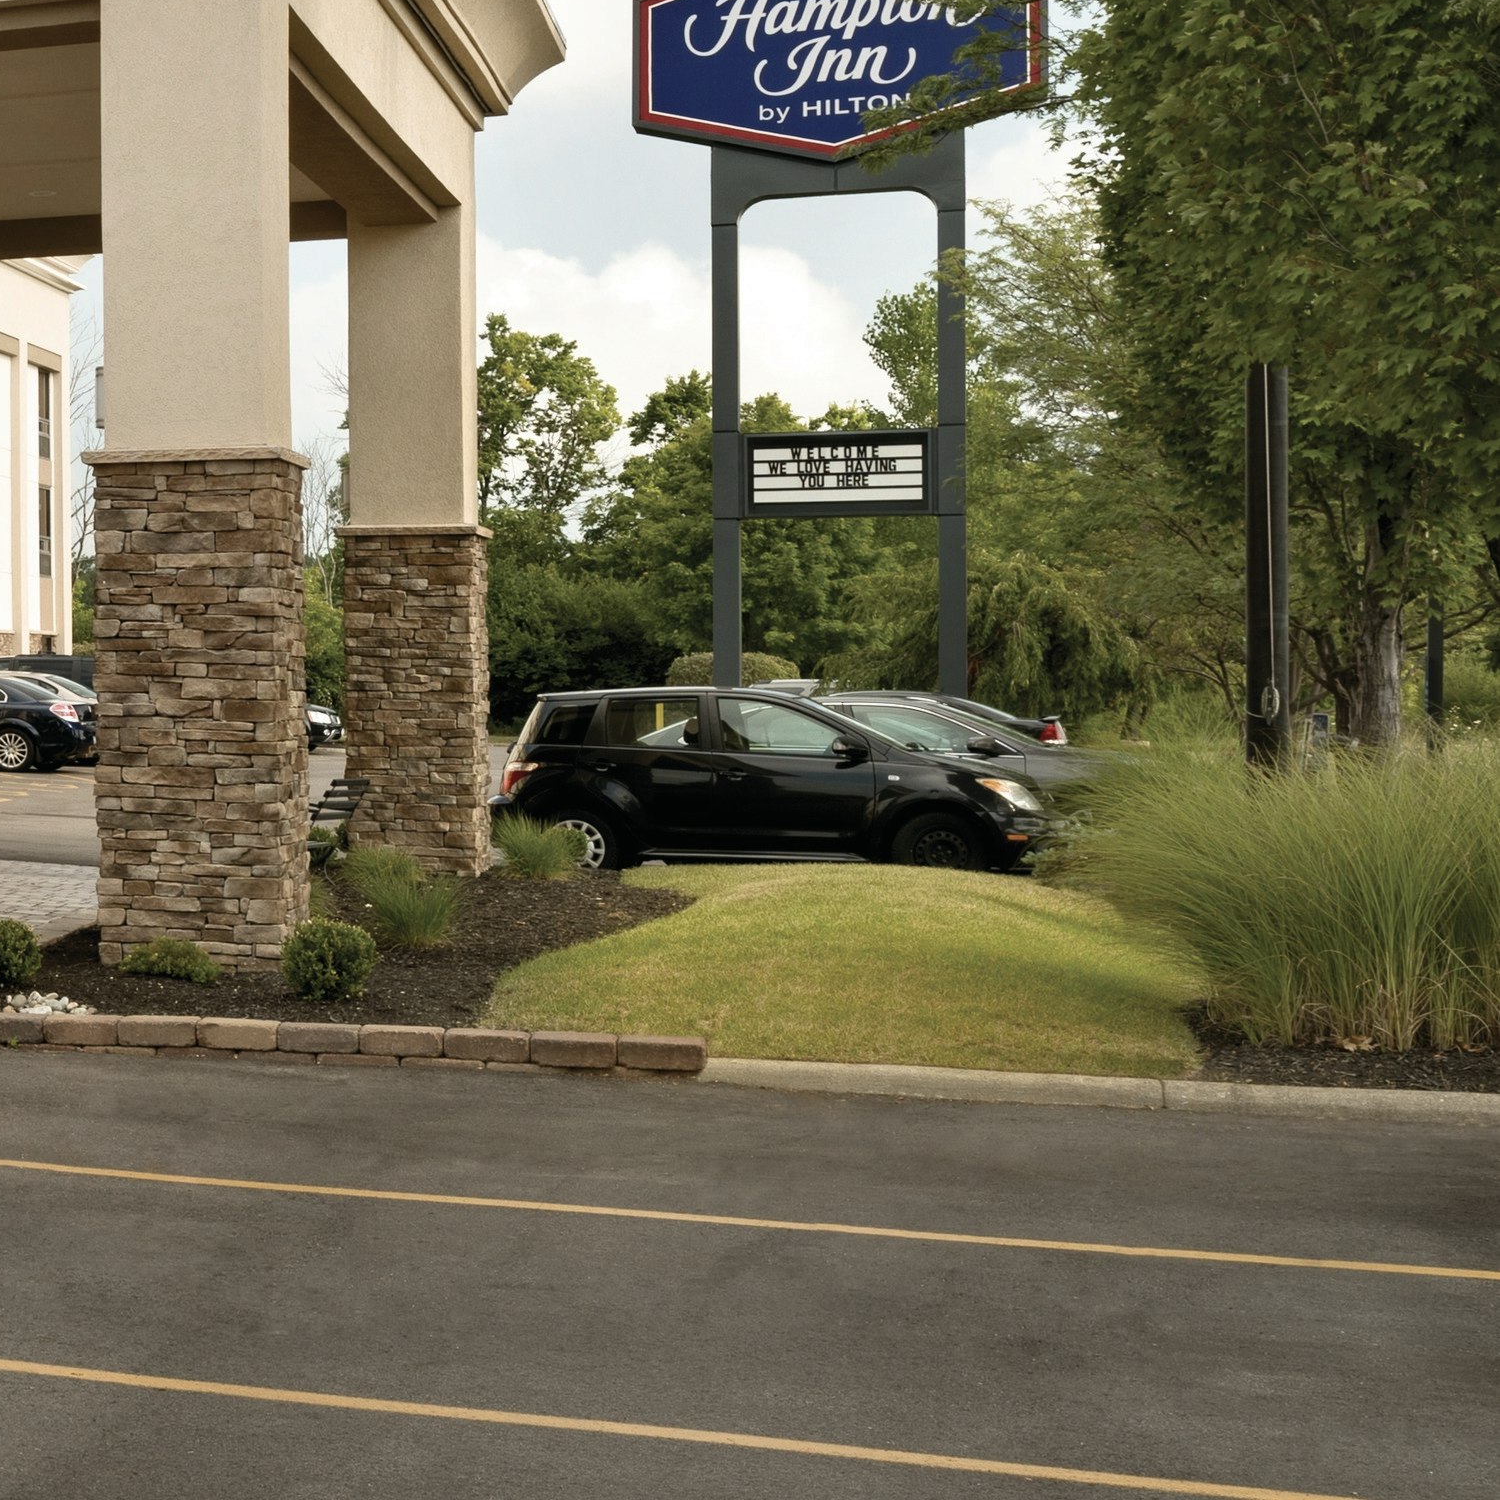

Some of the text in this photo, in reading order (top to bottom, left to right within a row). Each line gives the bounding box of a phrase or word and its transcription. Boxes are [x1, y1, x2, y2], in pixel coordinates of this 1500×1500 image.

[754, 35, 917, 96] Inn
[759, 105, 790, 124] by
[790, 446, 879, 460] WELCOME
[768, 459, 897, 475] WE LOVE HAVING
[799, 474, 869, 488] YOU HERE
